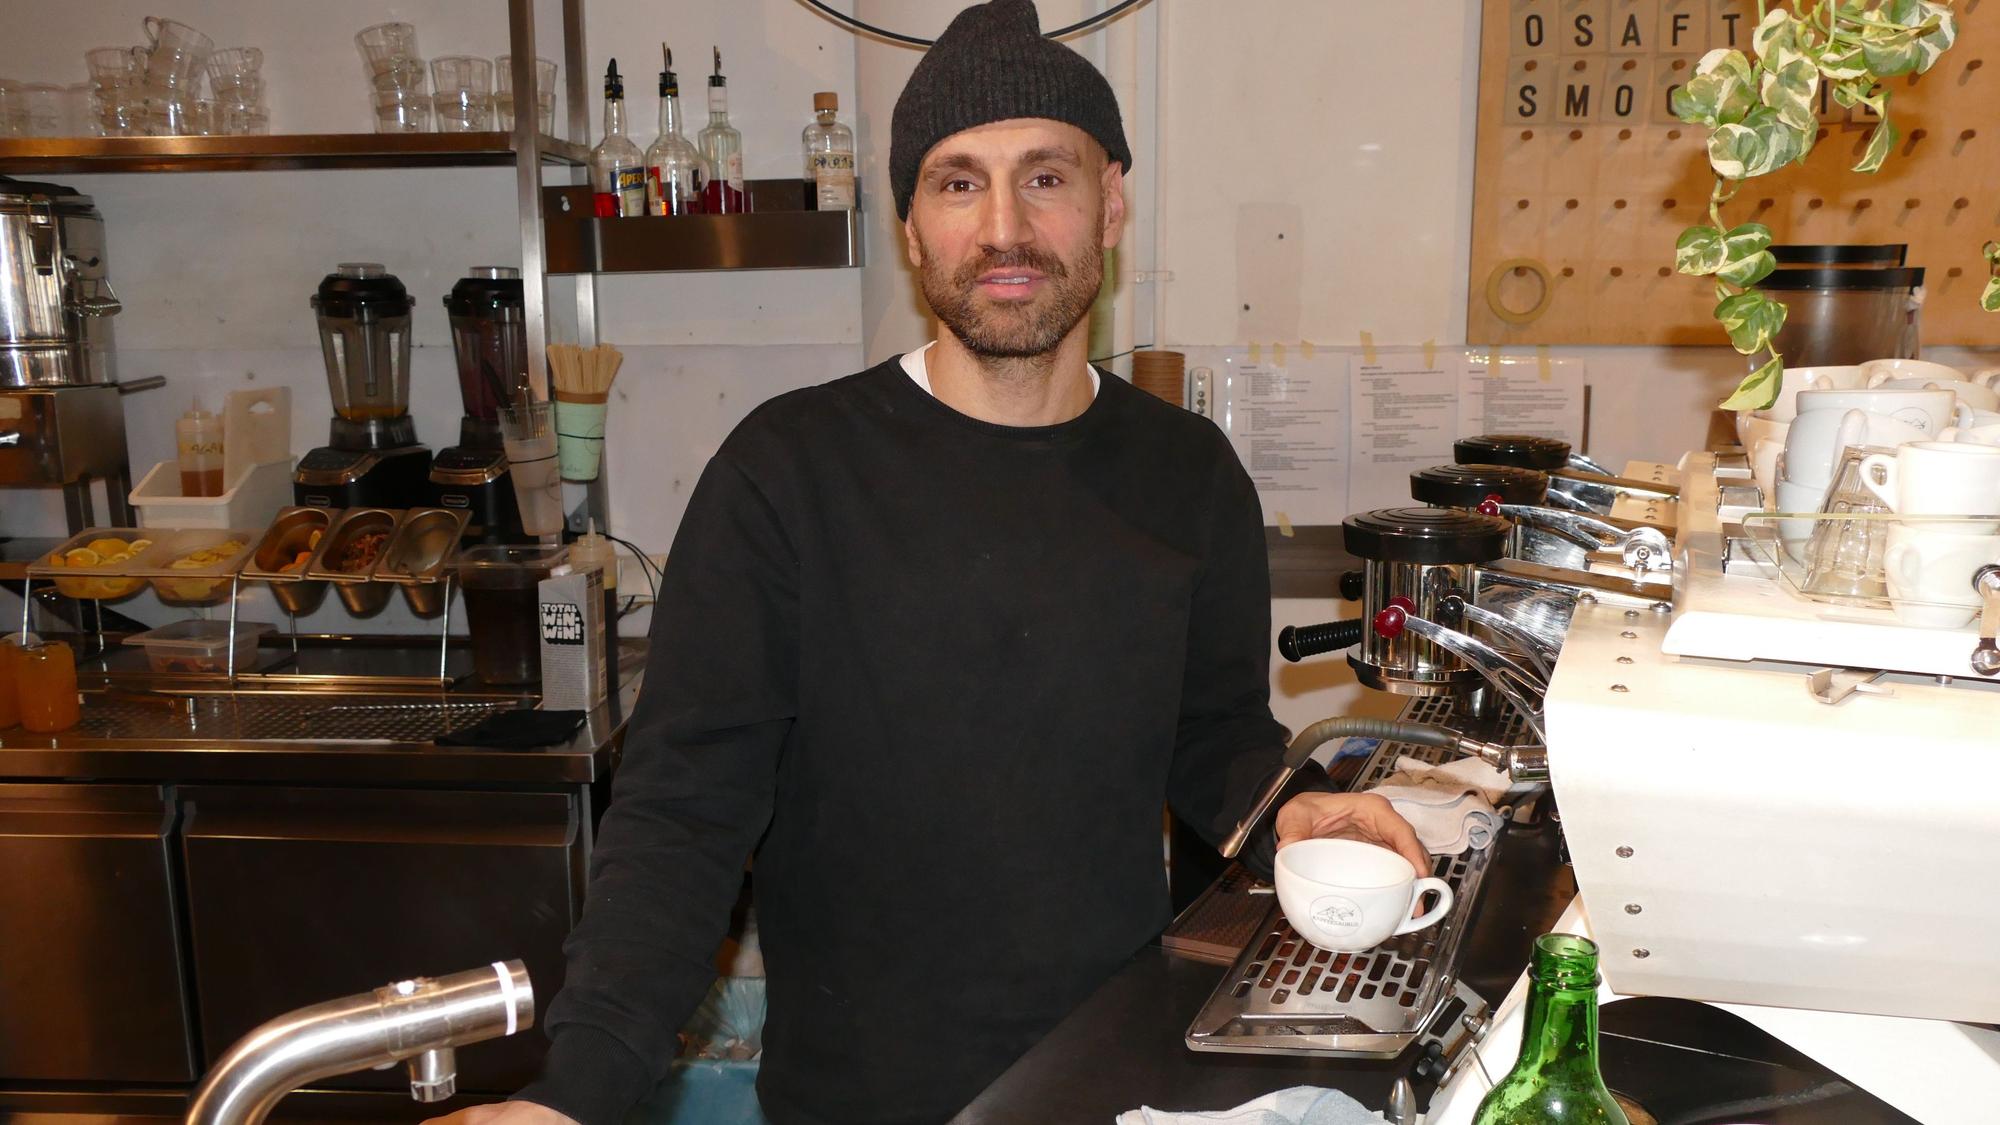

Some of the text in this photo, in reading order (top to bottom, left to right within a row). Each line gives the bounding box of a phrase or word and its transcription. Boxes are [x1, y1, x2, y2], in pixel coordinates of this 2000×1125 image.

[1525, 13, 1740, 47] OSAFT
[1517, 80, 1882, 118] SMOIE
[541, 603, 577, 613] TOTAL
